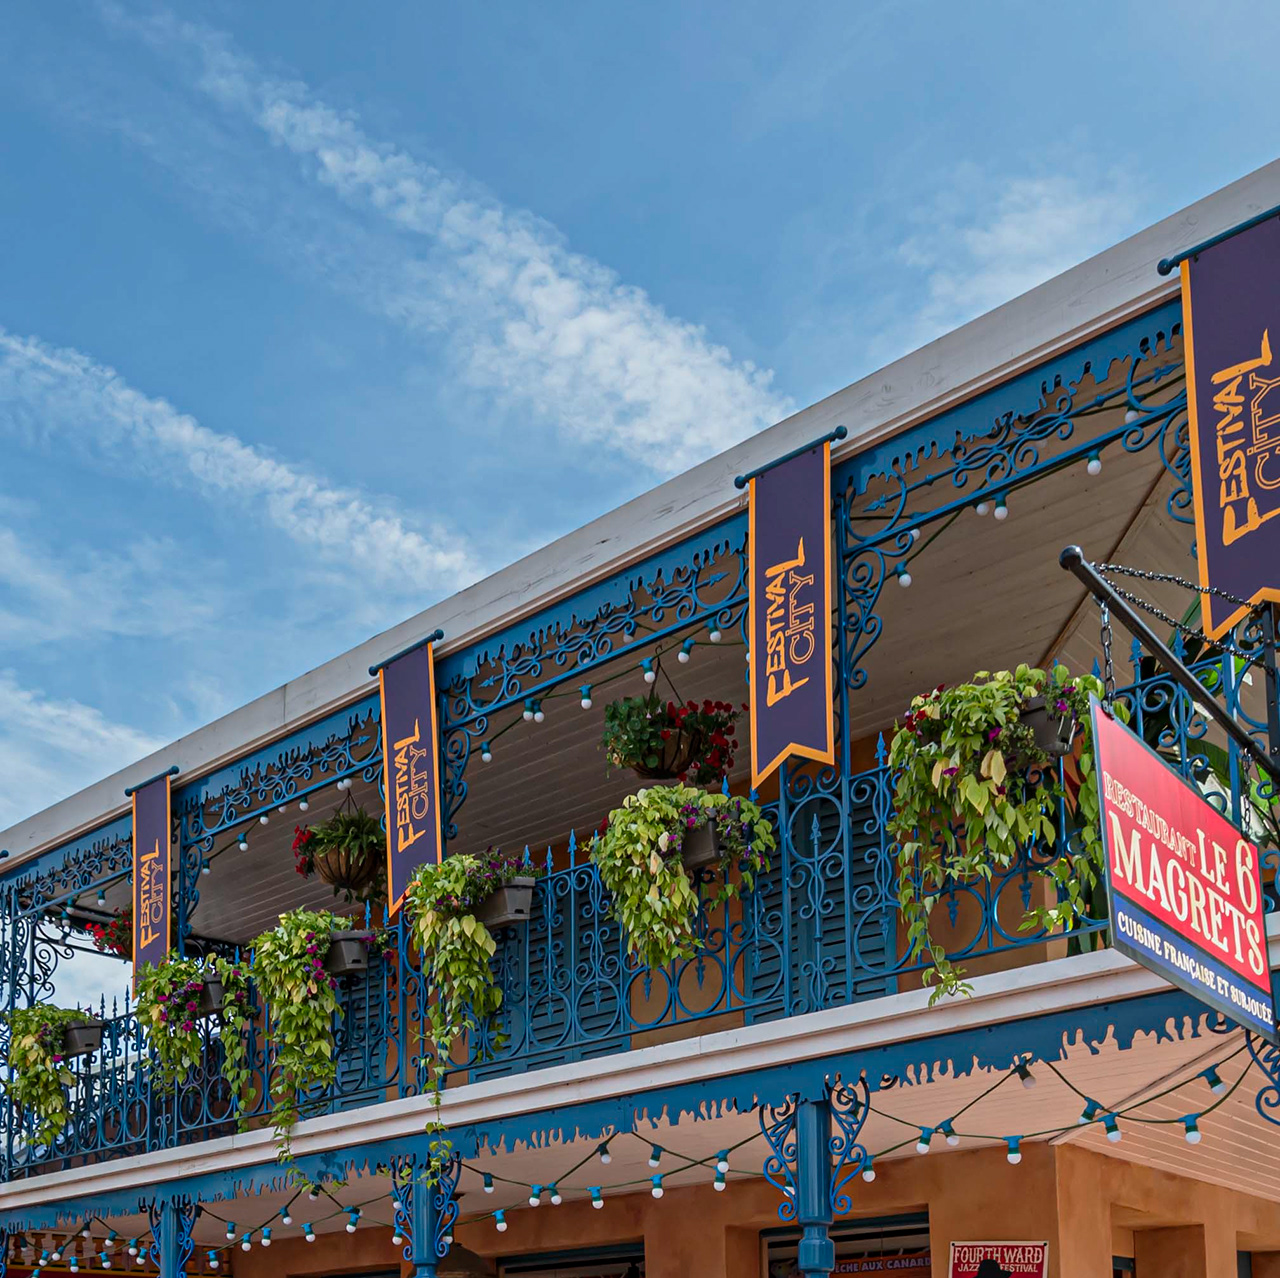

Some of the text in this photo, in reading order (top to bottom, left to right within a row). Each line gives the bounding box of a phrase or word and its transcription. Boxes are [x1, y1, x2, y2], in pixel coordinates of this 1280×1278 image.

[764, 536, 810, 707] FESTIVAL
[784, 570, 815, 666] CITY
[393, 718, 426, 853] FESTIVAL
[408, 745, 428, 820] CITY
[140, 838, 160, 950] FESTIVAL
[150, 860, 164, 924] CITY
[1103, 770, 1258, 915] RESTAURANT LE 6
[1108, 810, 1265, 977] MAGRETS
[1117, 910, 1274, 1026] CUISINE FRANÇAISE ET SURJOUÉE
[861, 1260, 883, 1271] AUX
[954, 1247, 1043, 1264] FOURTH WARD
[958, 1263, 1038, 1273] JAZZ FESTIVAL
